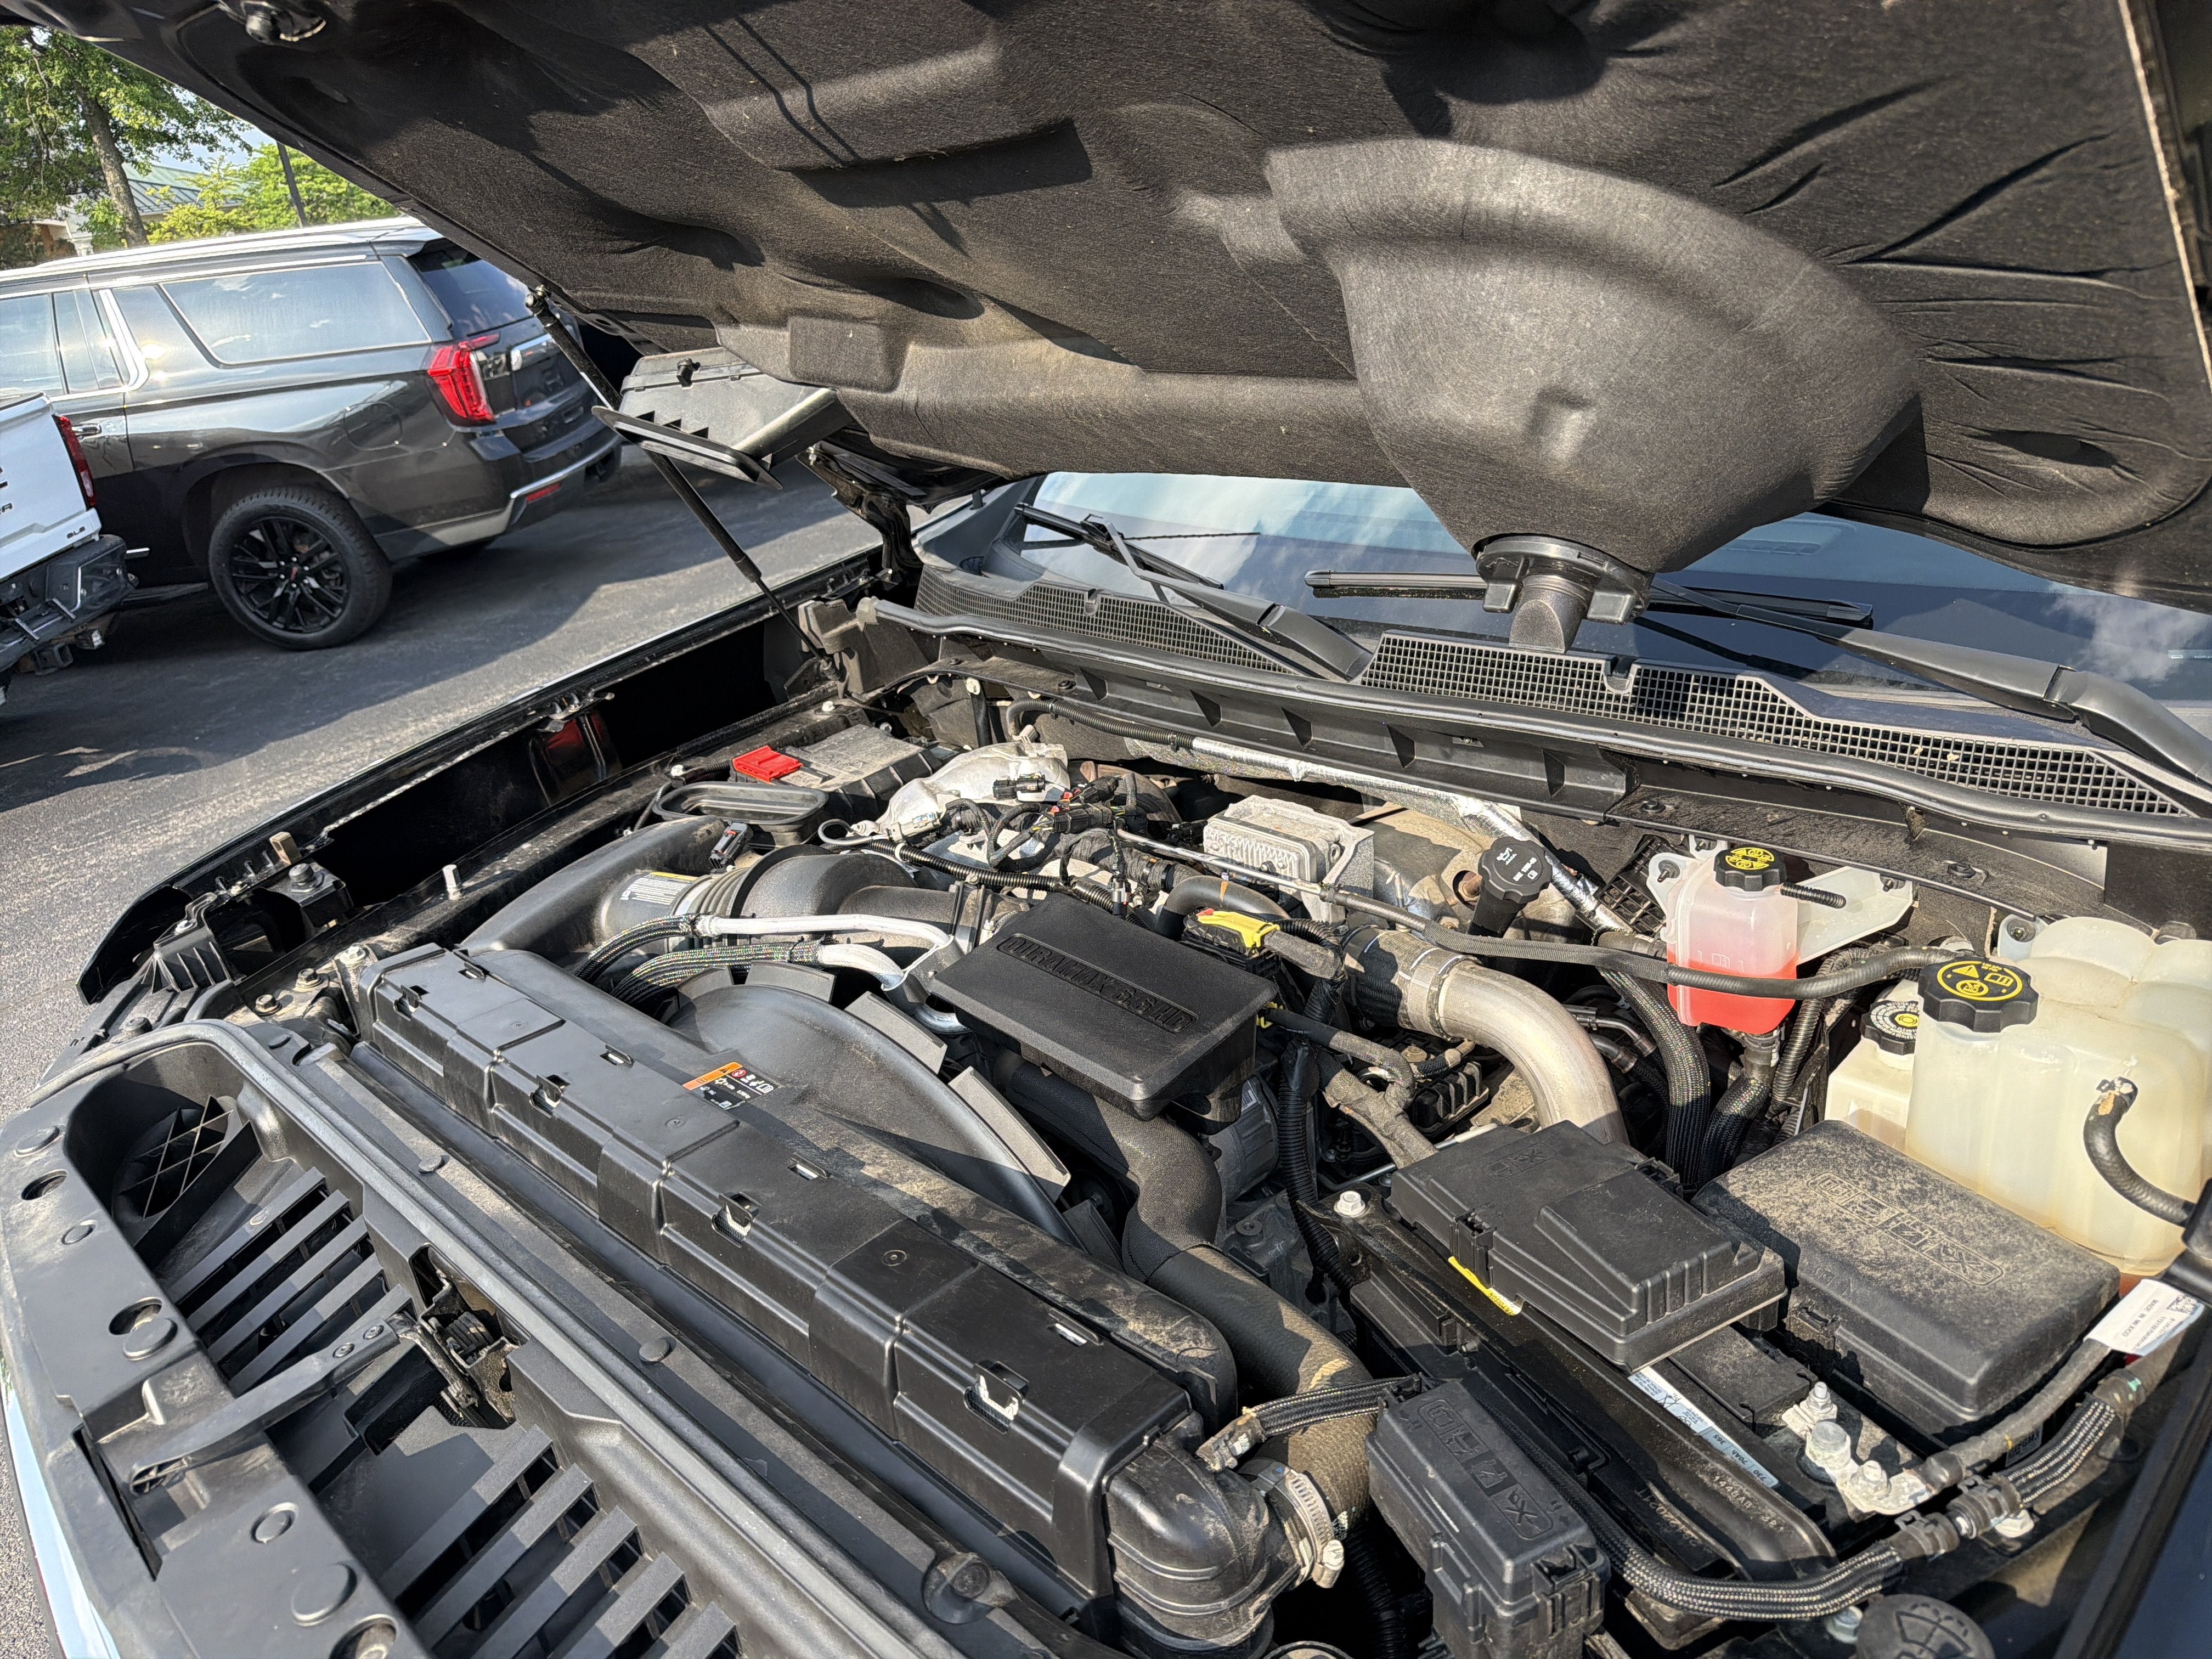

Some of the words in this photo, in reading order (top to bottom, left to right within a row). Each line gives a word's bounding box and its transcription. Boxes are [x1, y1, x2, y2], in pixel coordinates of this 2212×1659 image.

[1005, 938, 1116, 994] DURAMAX
[1115, 986, 1156, 1013] 6.6
[1712, 1434, 1726, 1444] 365
[1731, 1449, 1748, 1464] 70Ah
[1752, 1469, 1767, 1481] 730
